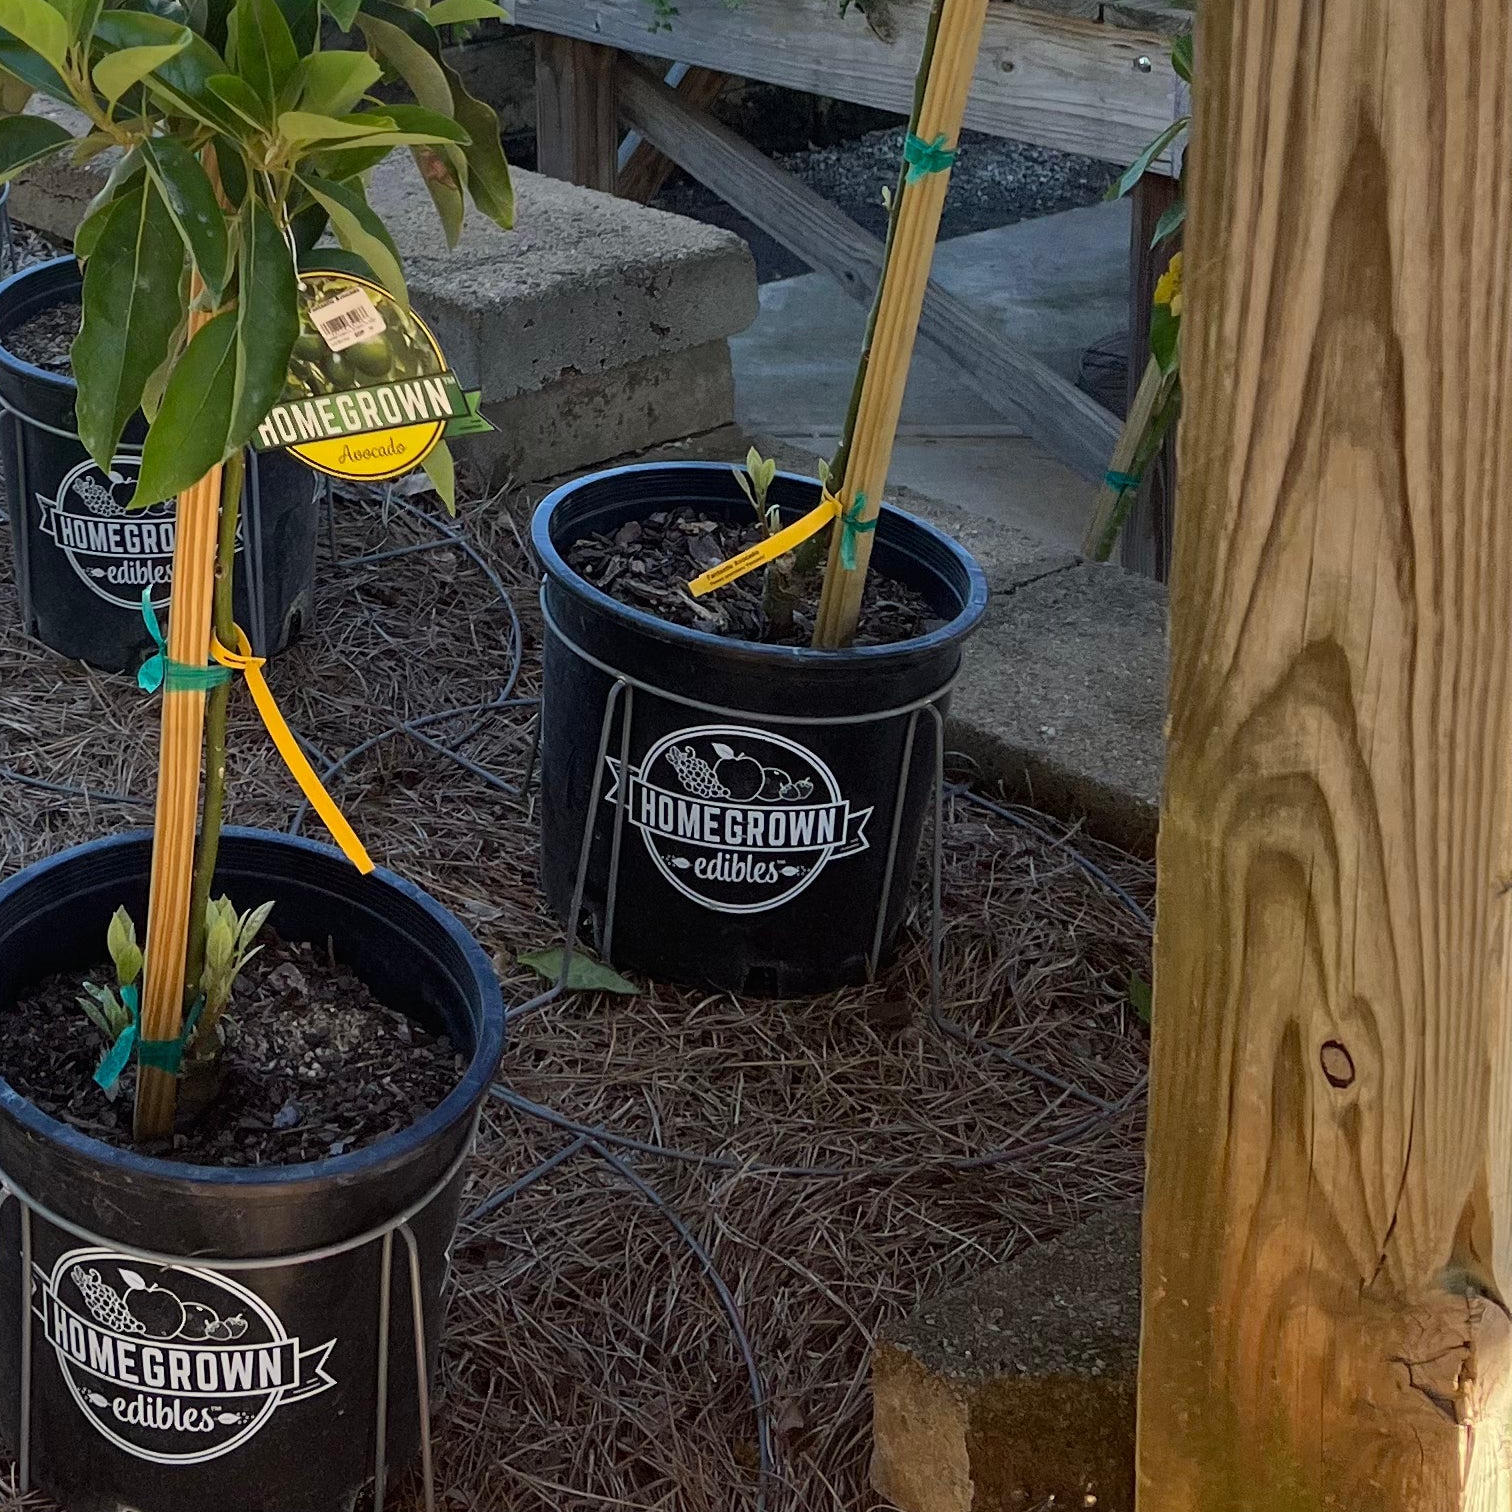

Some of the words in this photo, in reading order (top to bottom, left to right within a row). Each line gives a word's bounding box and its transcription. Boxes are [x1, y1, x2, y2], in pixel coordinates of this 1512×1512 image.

[338, 437, 406, 465] Avocado
[61, 516, 176, 553] HOMEGRO
[641, 786, 837, 847] HOMEGROWN
[694, 852, 779, 884] edibles
[53, 1302, 282, 1392] HOMEGROWN
[112, 1394, 215, 1432] edibles
